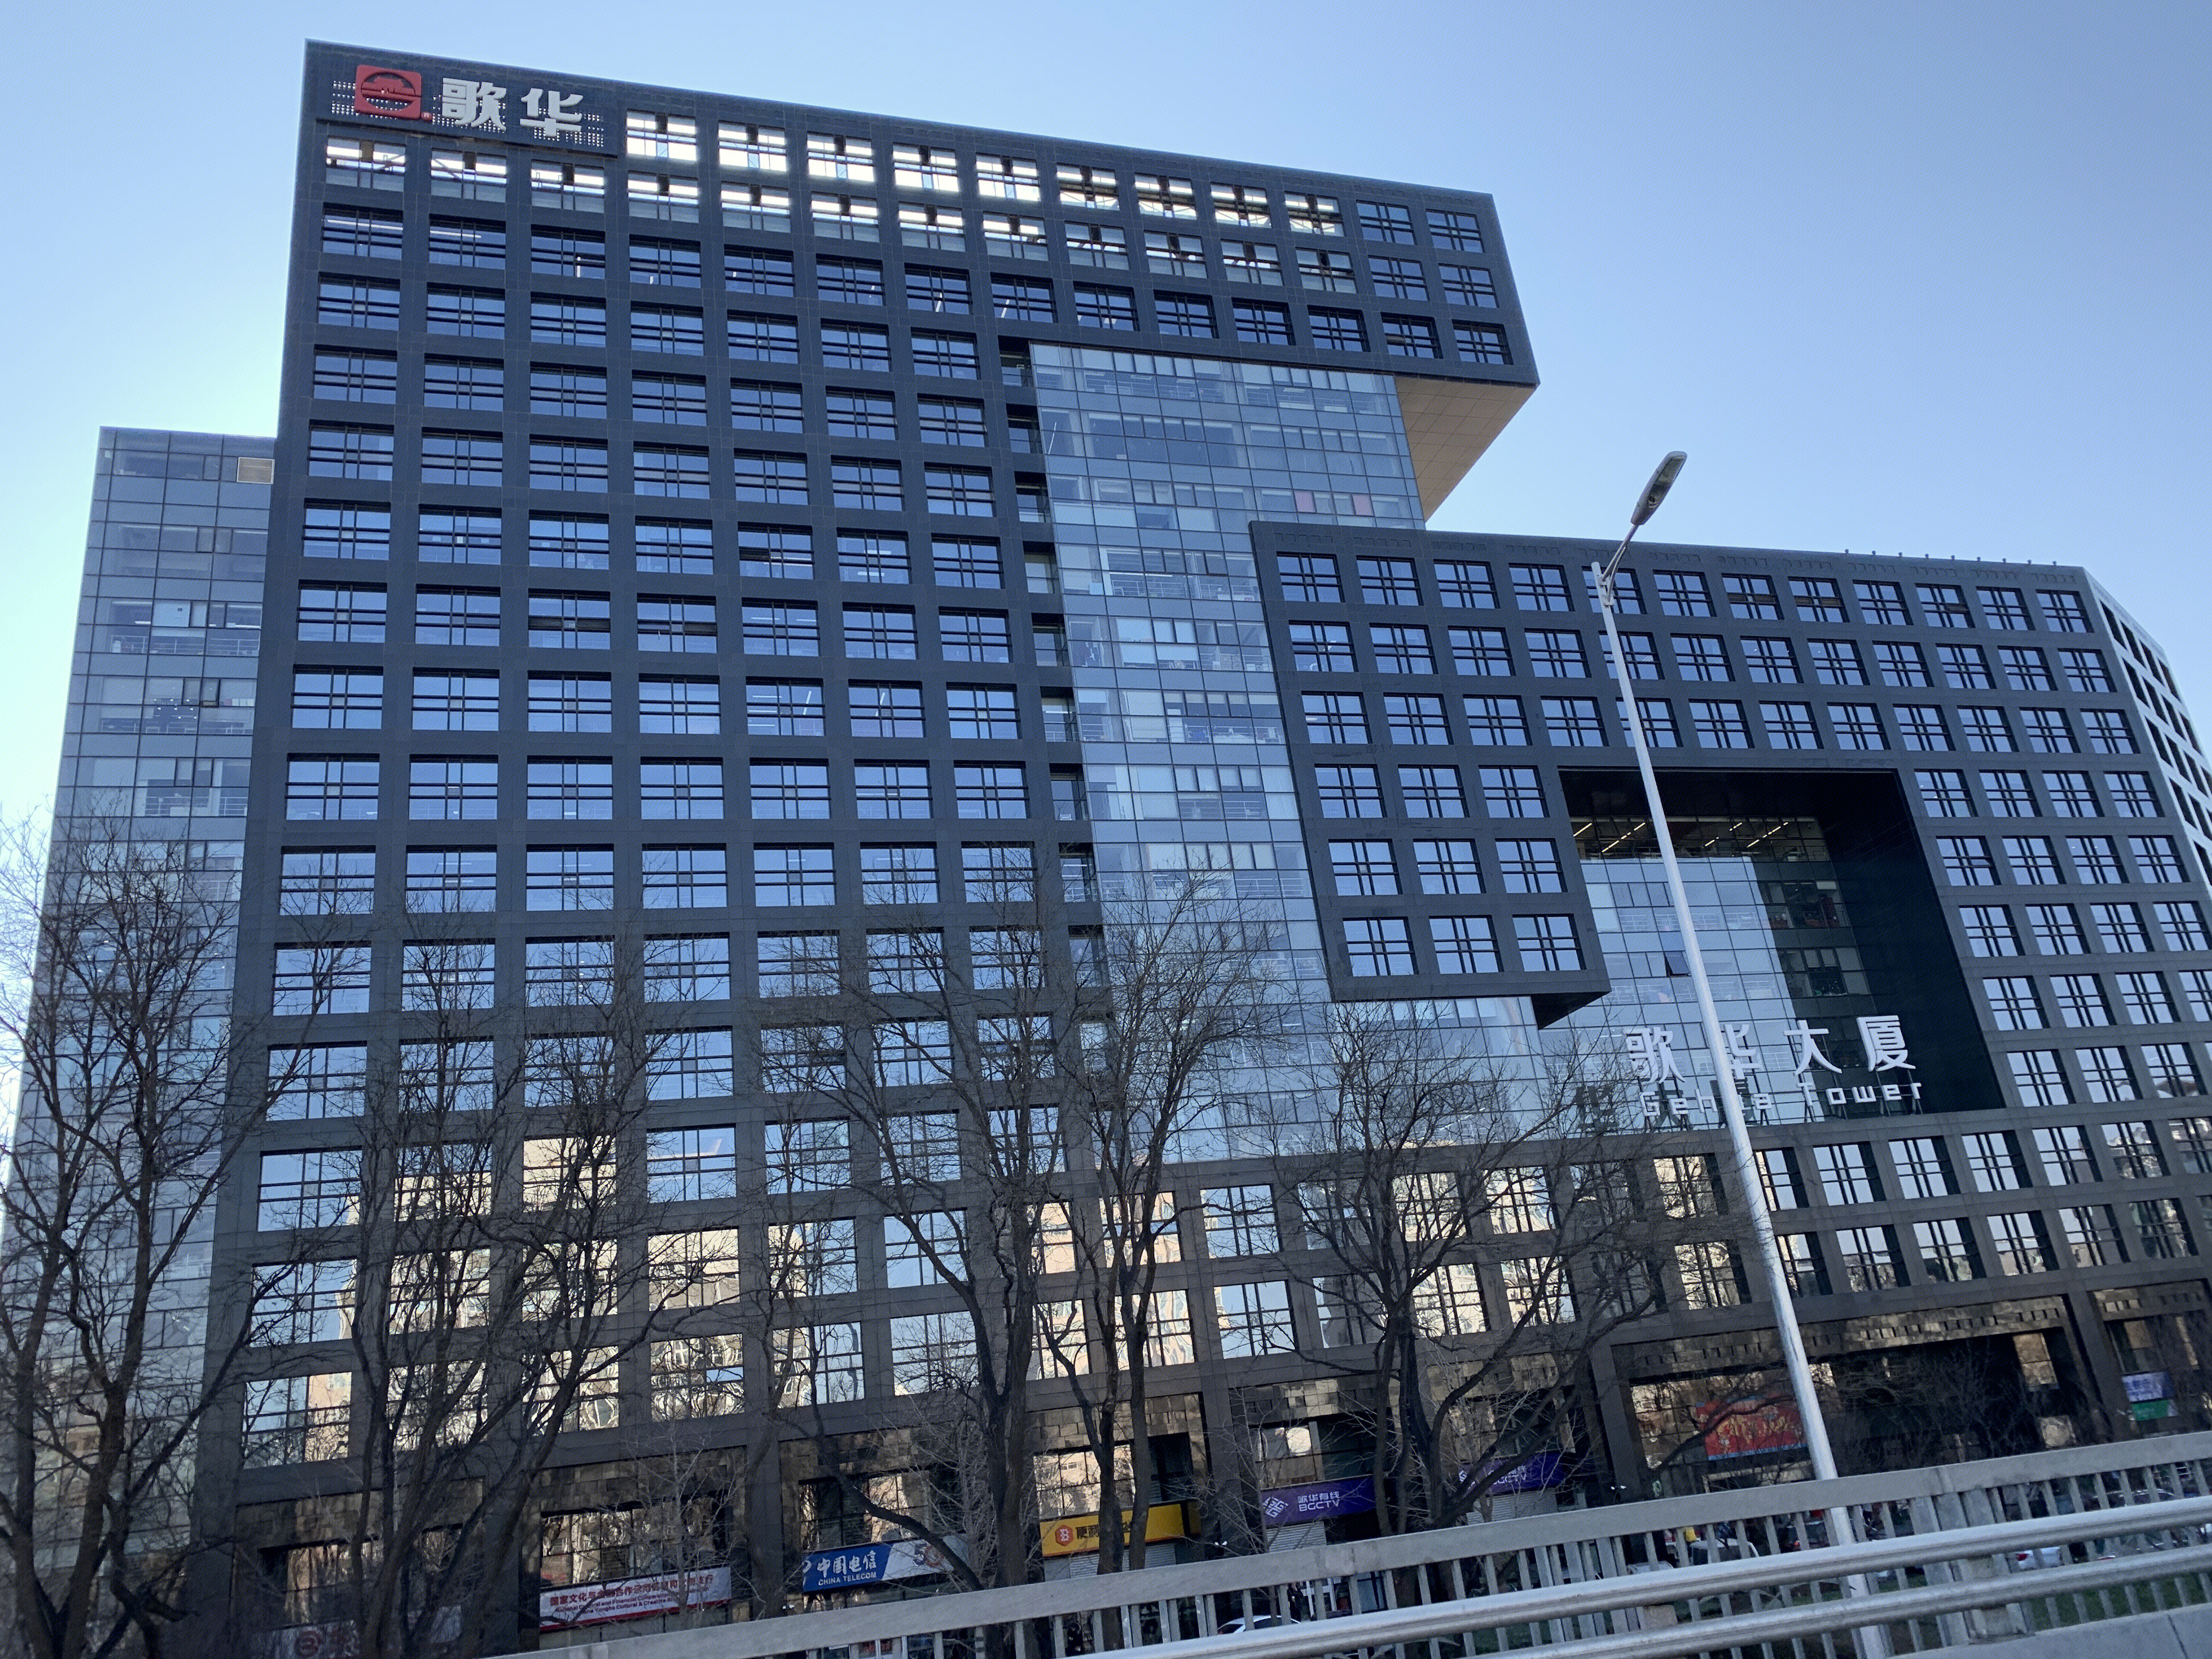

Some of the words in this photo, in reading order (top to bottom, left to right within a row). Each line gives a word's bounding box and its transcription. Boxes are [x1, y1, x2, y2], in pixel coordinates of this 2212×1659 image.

[442, 77, 584, 137] 歌华
[1623, 1015, 1916, 1084] 歌华大厦
[1796, 1082, 1922, 1107] Tower
[1297, 1491, 1340, 1504] 歌华有线
[1298, 1499, 1340, 1512] BGCTV
[817, 1550, 877, 1578] 中国电信
[818, 1577, 841, 1586] CHINA
[843, 1572, 877, 1582] TELECOM
